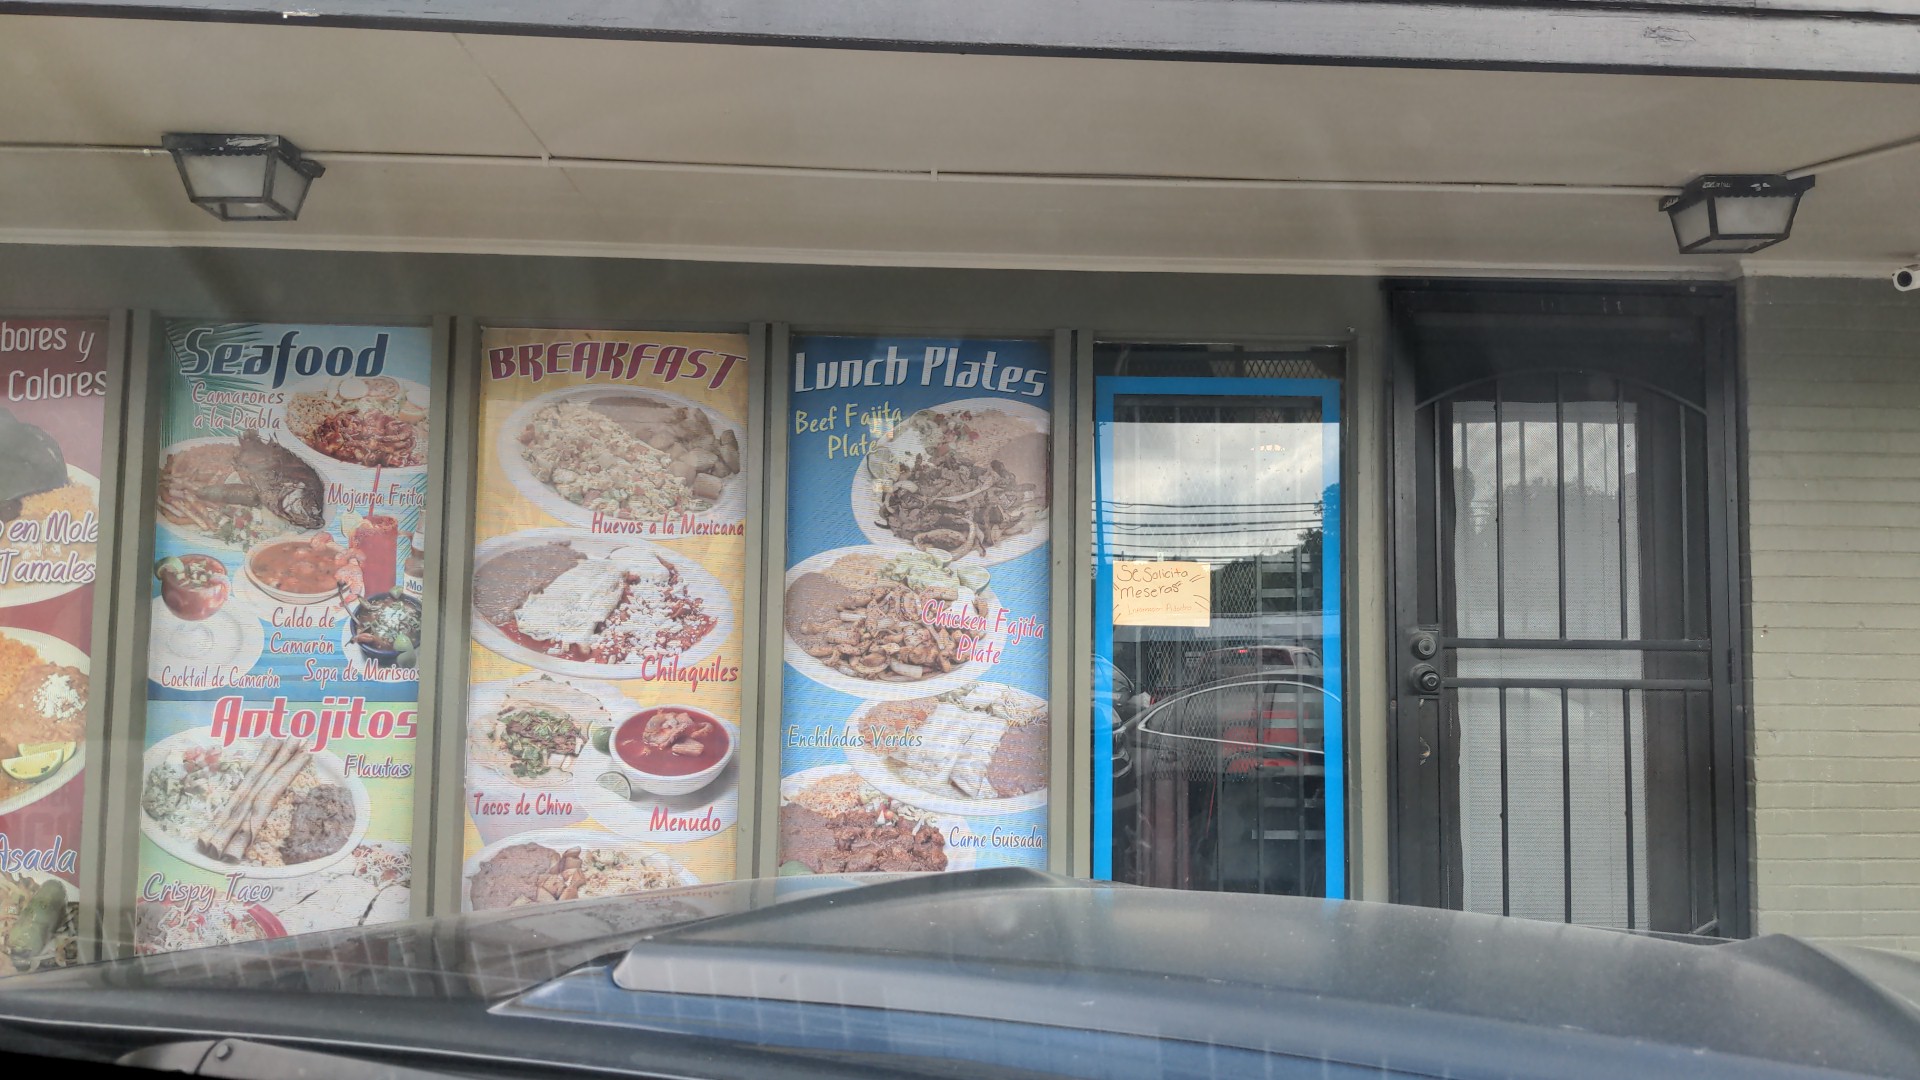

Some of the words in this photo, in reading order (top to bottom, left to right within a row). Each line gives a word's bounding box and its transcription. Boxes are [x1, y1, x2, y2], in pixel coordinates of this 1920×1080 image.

[1, 321, 67, 352] bores
[75, 330, 95, 363] y
[180, 328, 389, 389] Seafood
[488, 340, 748, 390] BREAKFAST
[795, 345, 909, 392] Lunch
[920, 346, 1047, 397] Plates
[8, 367, 107, 402] Colores
[192, 382, 284, 405] Camarones
[193, 415, 204, 427] a
[208, 409, 225, 428] la
[229, 408, 281, 430] Diabla
[795, 405, 838, 434] Beef
[844, 400, 903, 430] Fajita
[827, 434, 880, 460] Plate
[327, 482, 384, 514] Mojarra
[388, 482, 424, 506] Frita
[7, 519, 40, 542] en
[44, 510, 98, 544] Mole
[591, 512, 643, 535] Huevos
[650, 521, 657, 534] a
[662, 514, 675, 534] la
[680, 514, 745, 537] Mexicana
[0, 549, 96, 584] Tamales
[271, 606, 314, 630] Caldo
[318, 608, 335, 629] de
[921, 599, 987, 631] Chicken
[994, 607, 1045, 645] Fajita
[269, 631, 335, 655] Camarón
[956, 634, 1001, 664] Plate
[161, 665, 208, 688] Cocktail
[210, 667, 225, 687] de
[228, 667, 281, 689] Camarón
[302, 659, 338, 689] Sopa
[342, 658, 359, 682] de
[640, 654, 739, 693] Chilaquiles
[209, 695, 418, 753] Antojitos
[788, 725, 866, 748] Enchiladas
[871, 725, 923, 748] Verdes
[343, 754, 413, 779] Flautas
[473, 792, 509, 815] Tacos
[515, 792, 530, 815] de
[535, 792, 573, 816] Chivo
[649, 805, 721, 832] Menudo
[949, 826, 986, 848] Carne
[991, 826, 1043, 849] Guisada
[142, 873, 215, 912] Crispy
[223, 871, 274, 901] Taco
